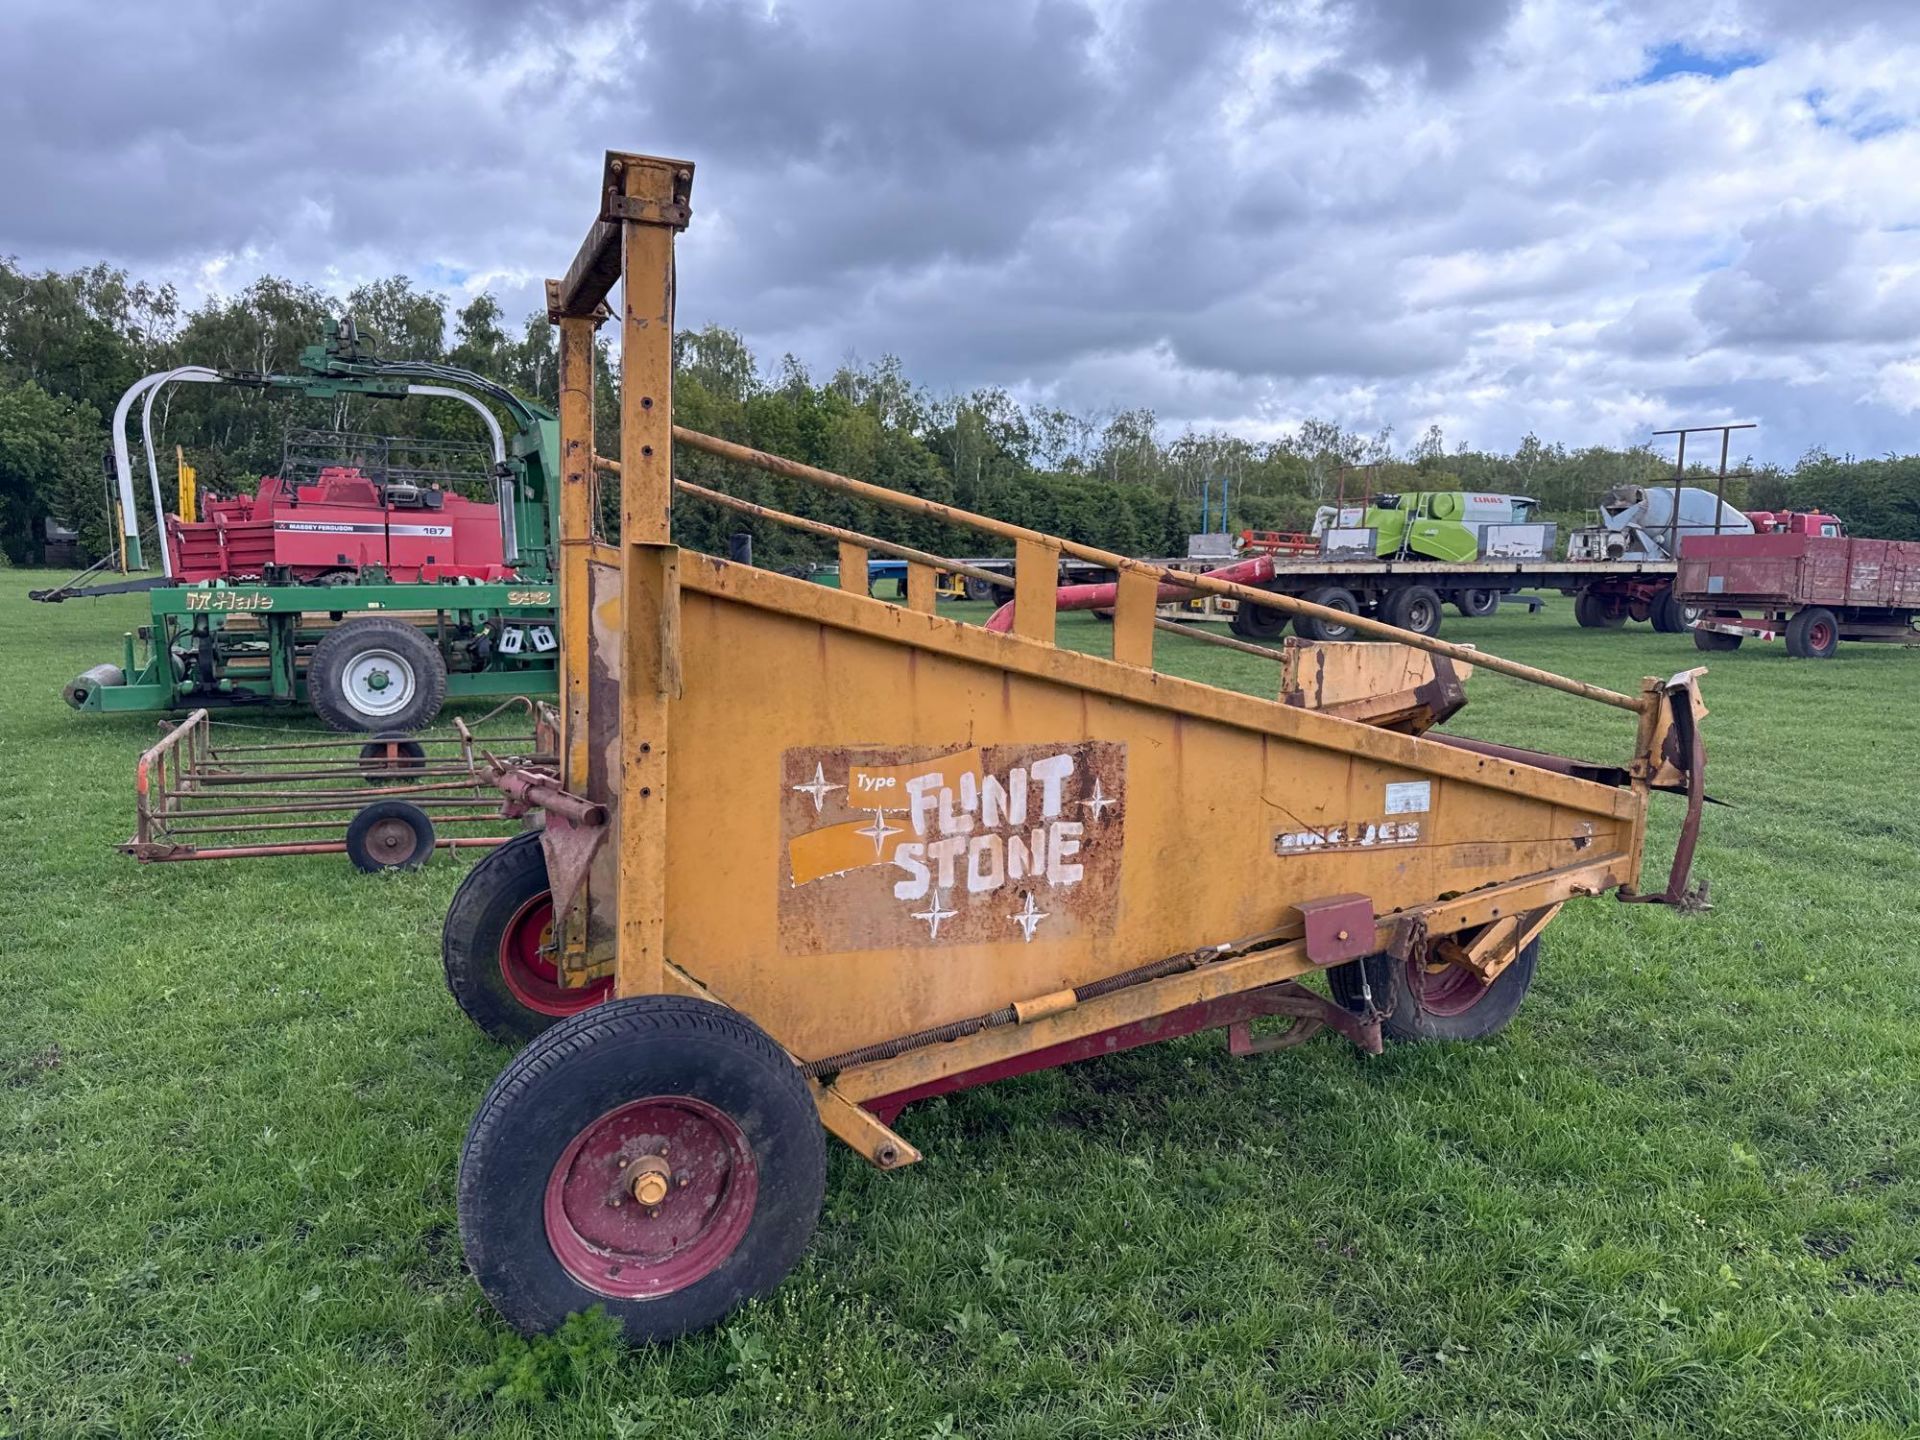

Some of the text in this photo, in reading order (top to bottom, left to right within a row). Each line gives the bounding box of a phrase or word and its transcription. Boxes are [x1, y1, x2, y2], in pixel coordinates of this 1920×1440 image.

[1472, 496, 1503, 504] CLAAS
[289, 523, 354, 532] MASSEY FERGUSON
[423, 527, 445, 536] 187
[856, 773, 896, 792] Type
[906, 753, 1075, 836] FLINT
[893, 821, 1085, 901] STONE
